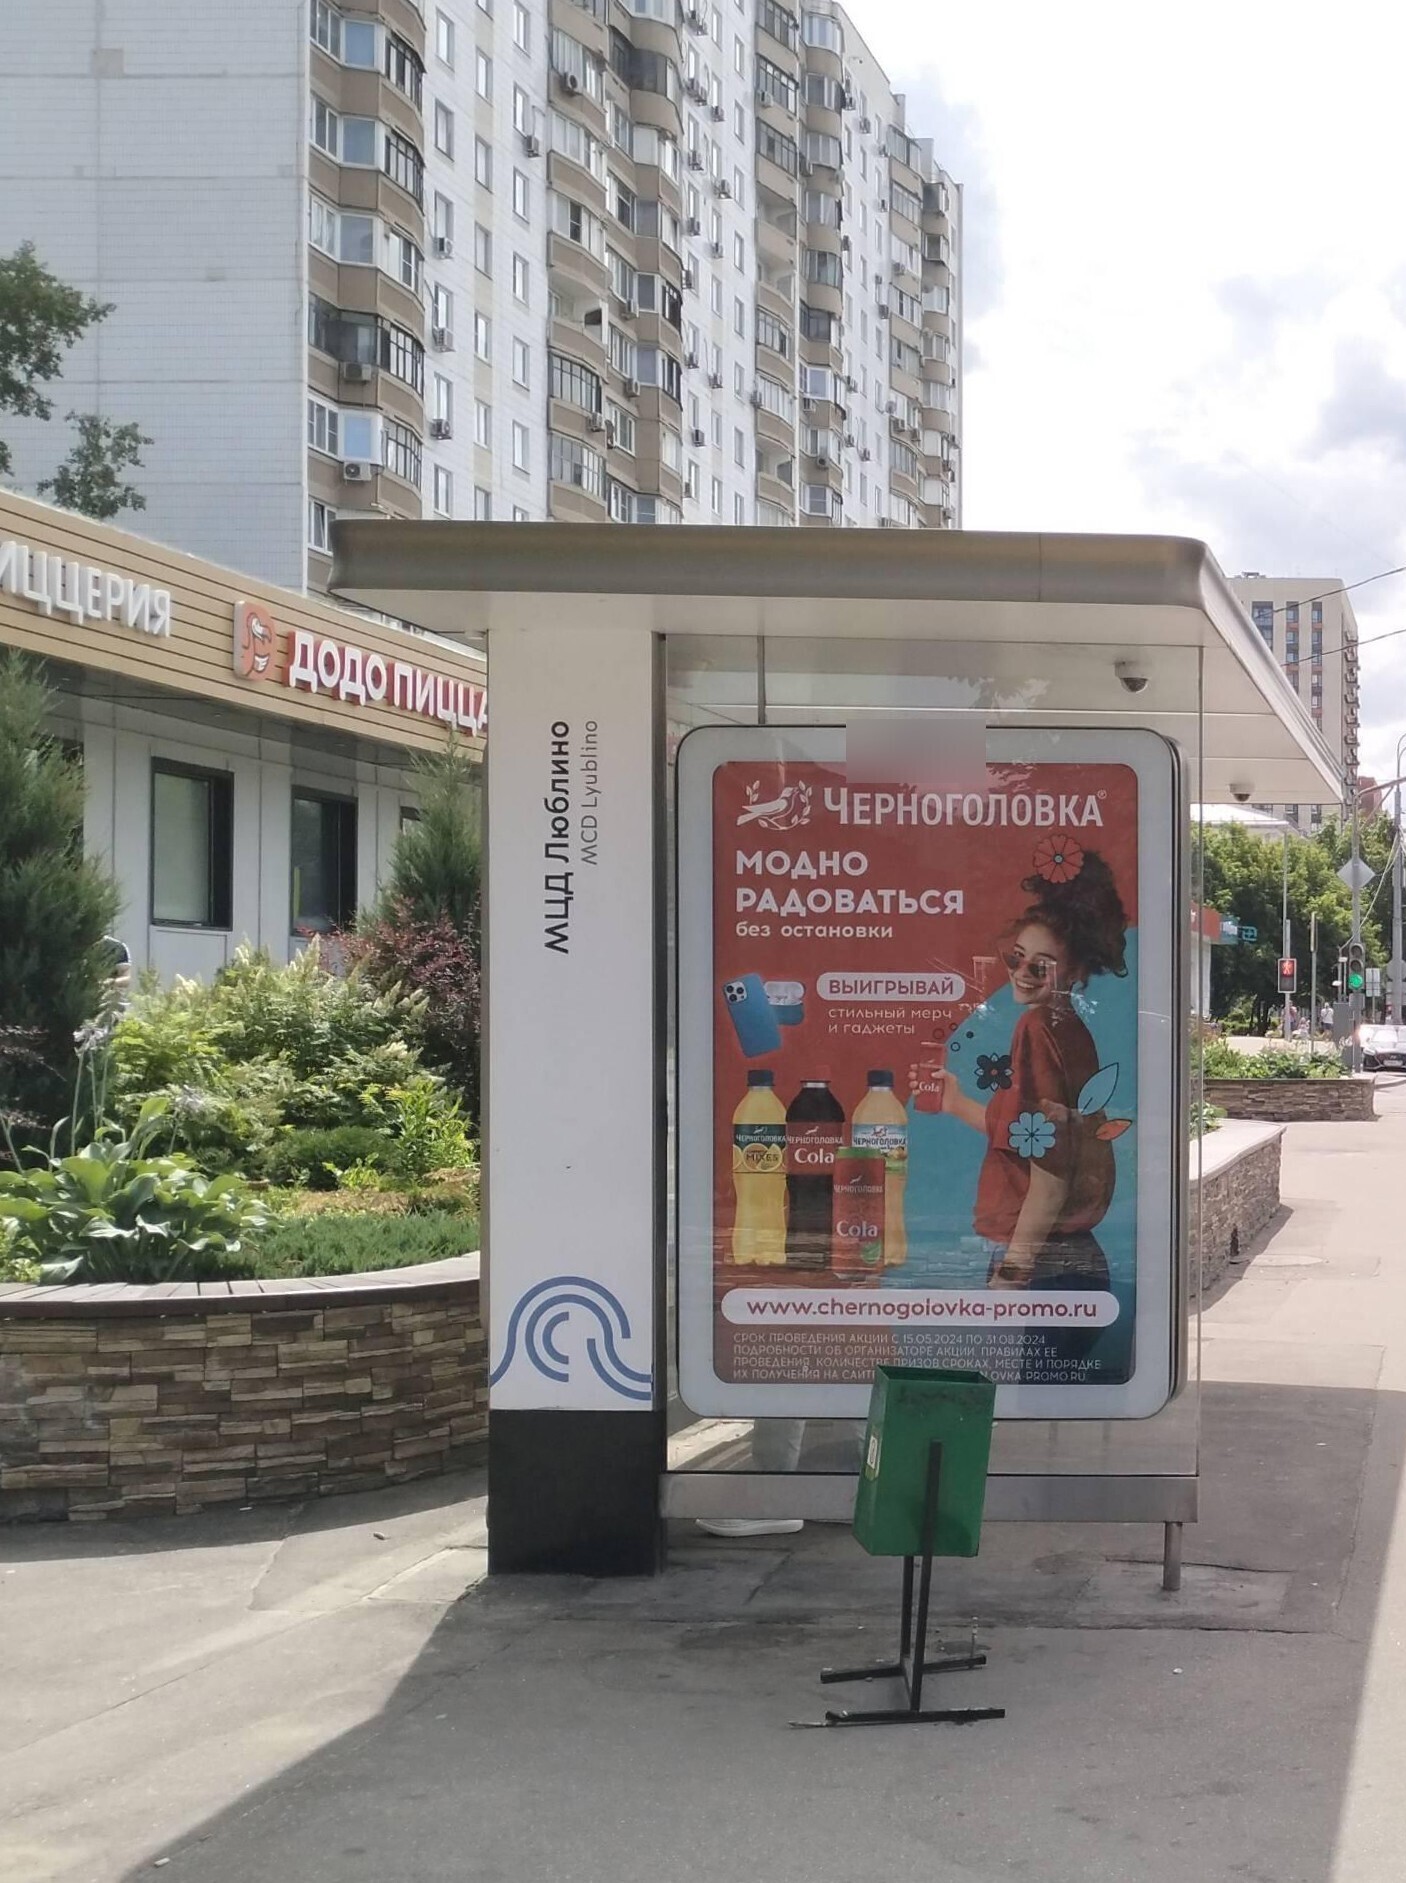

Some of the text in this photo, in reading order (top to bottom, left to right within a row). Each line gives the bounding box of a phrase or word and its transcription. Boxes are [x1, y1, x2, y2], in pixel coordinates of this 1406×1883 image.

[285, 631, 388, 706] ДОДО
[580, 720, 602, 865] MCD Lyublino
[824, 787, 1104, 827] ЧЕРНОГОЛОВКА
[543, 721, 574, 955] МЦД Люблино
[736, 850, 868, 880] МОДНО
[736, 888, 964, 917] РАДОВАТЬСЯ
[736, 921, 893, 939] без остановки
[829, 977, 953, 996] ВЫИГРЫВАЙ
[828, 1007, 952, 1022] стильный мерч
[828, 1023, 915, 1035] и гаджеты
[919, 1081, 940, 1093] Cola
[794, 1147, 835, 1164] Cola
[836, 1220, 878, 1238] Cola
[746, 1297, 1097, 1321] www.chernogolovka-promo.ru
[733, 1333, 766, 1343] СРОК
[769, 1333, 846, 1343] ПРОВЕДЕНИЯ
[849, 1334, 888, 1344] АКЦИИ
[891, 1334, 899, 1343] С
[965, 1334, 983, 1344] ПО
[733, 1344, 821, 1355] ПОДРОБНОСТИ
[825, 1345, 842, 1355] ОБ
[844, 1345, 933, 1356] ОРГАНИЗАТОРЕ
[981, 1346, 1040, 1357] ПРАВИЛАХ
[1044, 1347, 1058, 1357] ЕЕ
[994, 1359, 1033, 1369] МЕСТЕ
[1035, 1359, 1043, 1369] И
[1046, 1359, 1101, 1370] ПОРЯДКЕ
[733, 1369, 748, 1379] ИХ
[752, 1369, 820, 1379] ПОЛУЧЕНИЯ
[823, 1370, 838, 1379] НА
